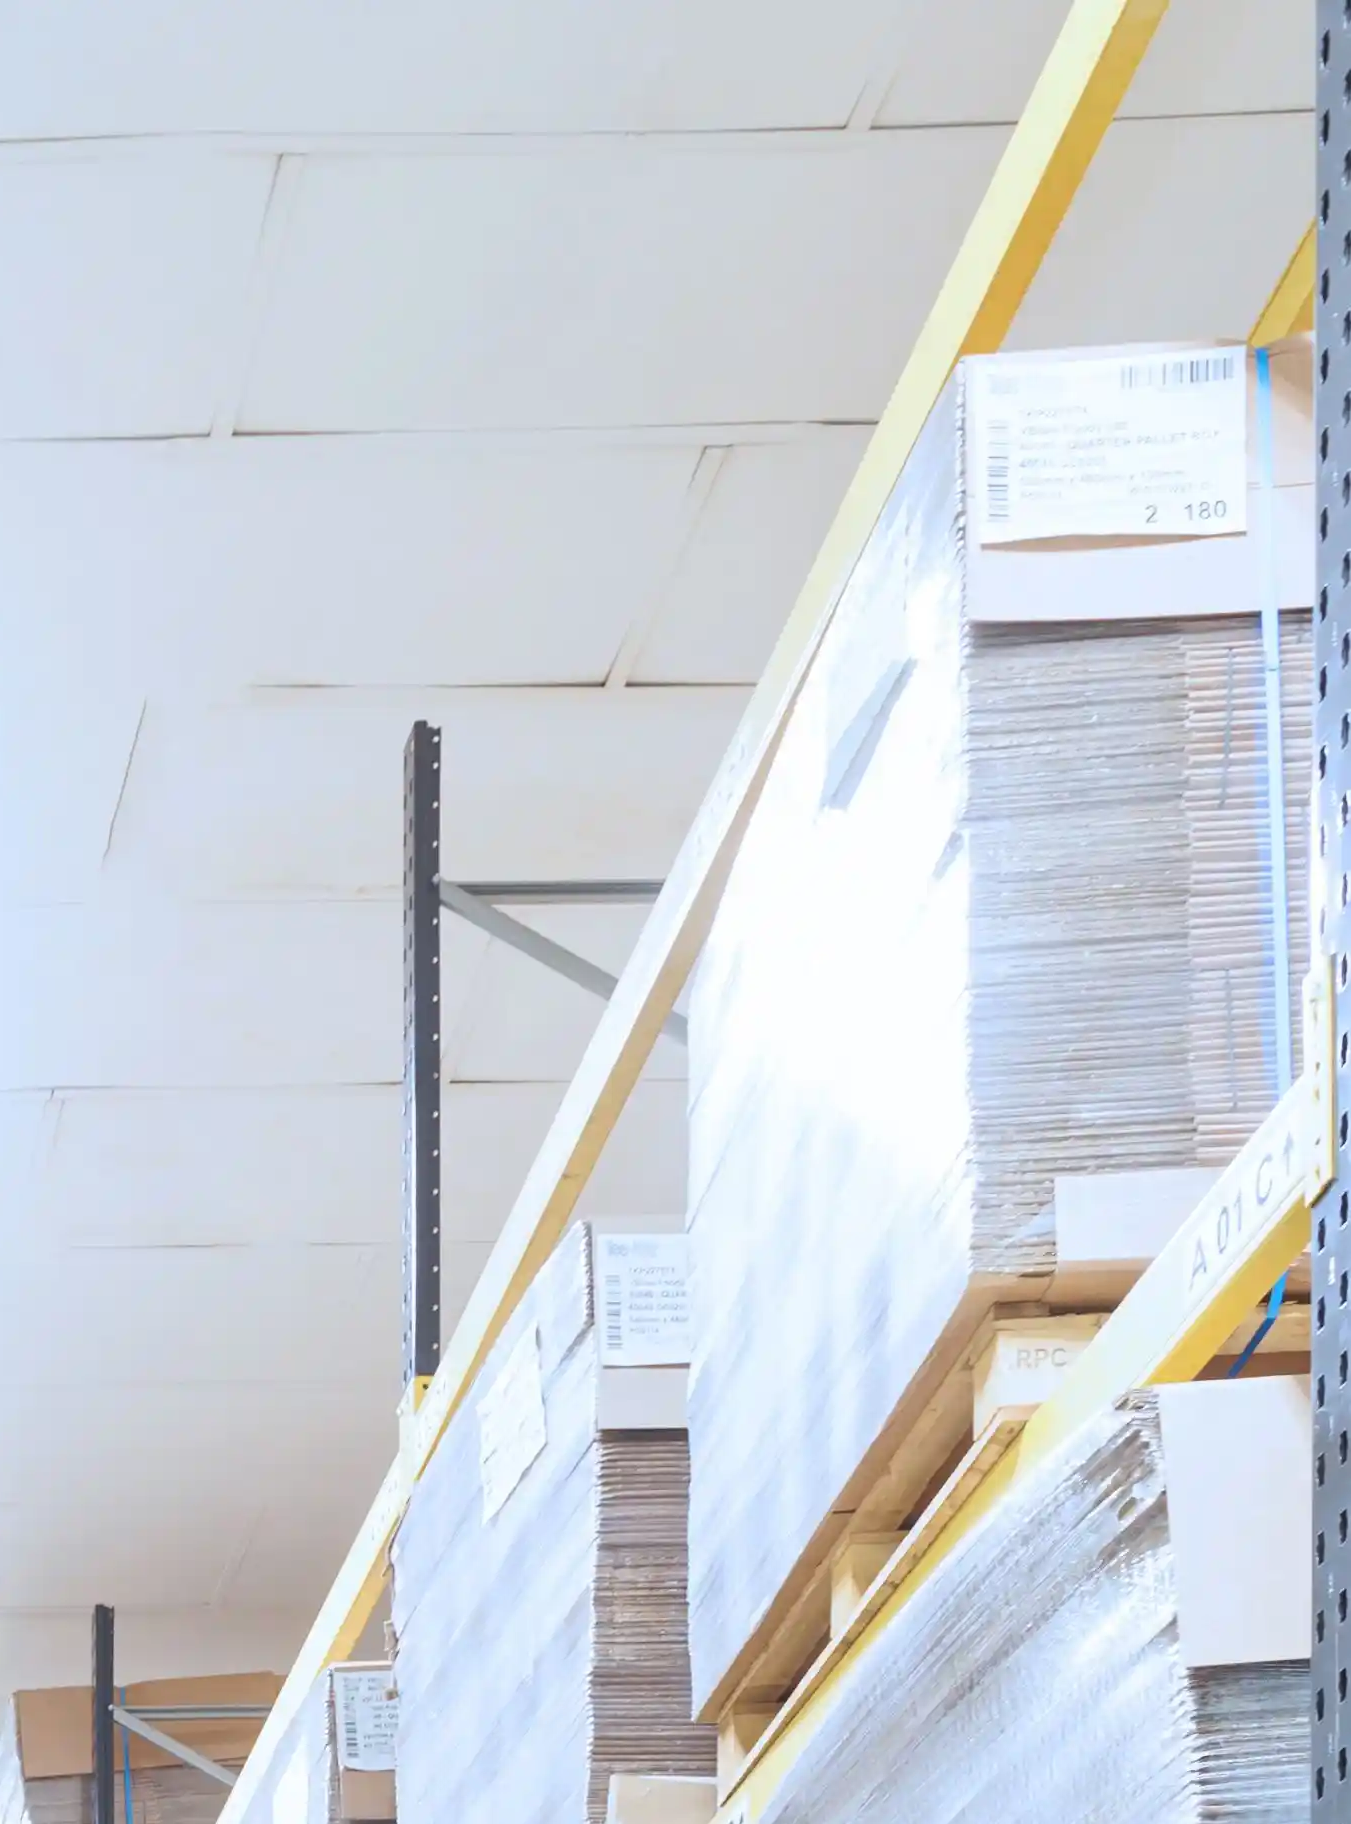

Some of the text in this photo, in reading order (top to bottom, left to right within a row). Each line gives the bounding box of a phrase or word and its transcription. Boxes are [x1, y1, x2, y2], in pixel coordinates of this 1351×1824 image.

[1144, 499, 1228, 525] 2 180
[1188, 1235, 1208, 1289] A
[1255, 1151, 1273, 1206] C
[1016, 1347, 1068, 1370] RPC
